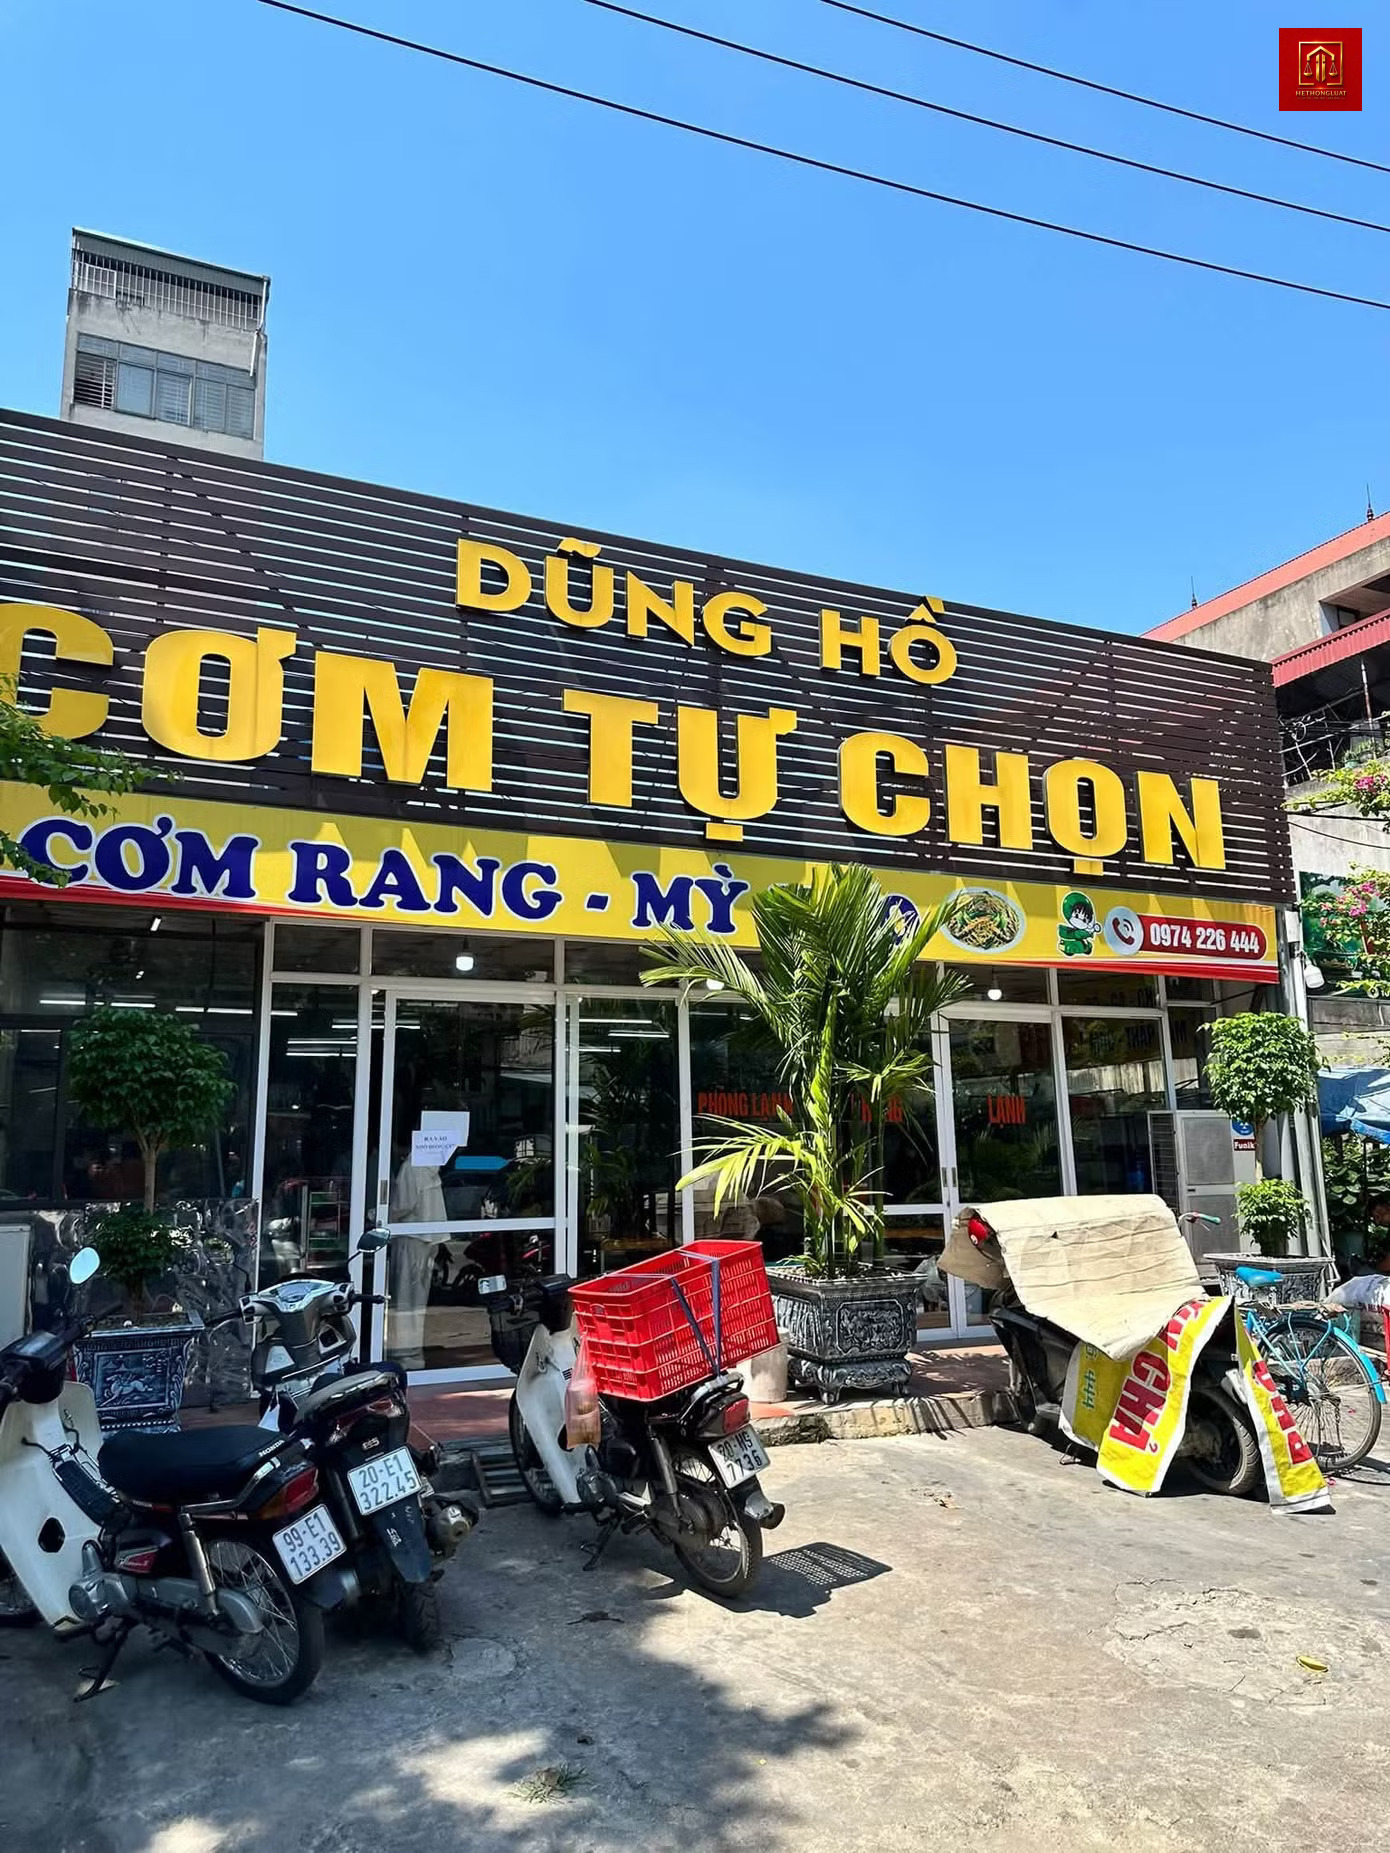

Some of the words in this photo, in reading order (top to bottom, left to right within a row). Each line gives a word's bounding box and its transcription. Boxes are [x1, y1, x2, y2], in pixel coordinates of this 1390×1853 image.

[457, 537, 772, 657] DŨNG
[818, 594, 958, 685] HỒ
[0, 602, 494, 792] CƠM
[562, 688, 797, 842] TỰ
[838, 732, 1227, 876] CHỌN
[17, 813, 261, 901] CƠM
[287, 840, 564, 921] RANG
[631, 863, 750, 936] MỲ
[1150, 922, 1192, 948] 0974
[1196, 926, 1226, 951] 226
[1230, 930, 1260, 954] 444
[358, 1454, 404, 1488] 20-E1
[727, 1449, 762, 1481] 7736
[360, 1470, 417, 1511] 322.45
[283, 1512, 327, 1553] 99-E1
[290, 1532, 341, 1577] 133.39
